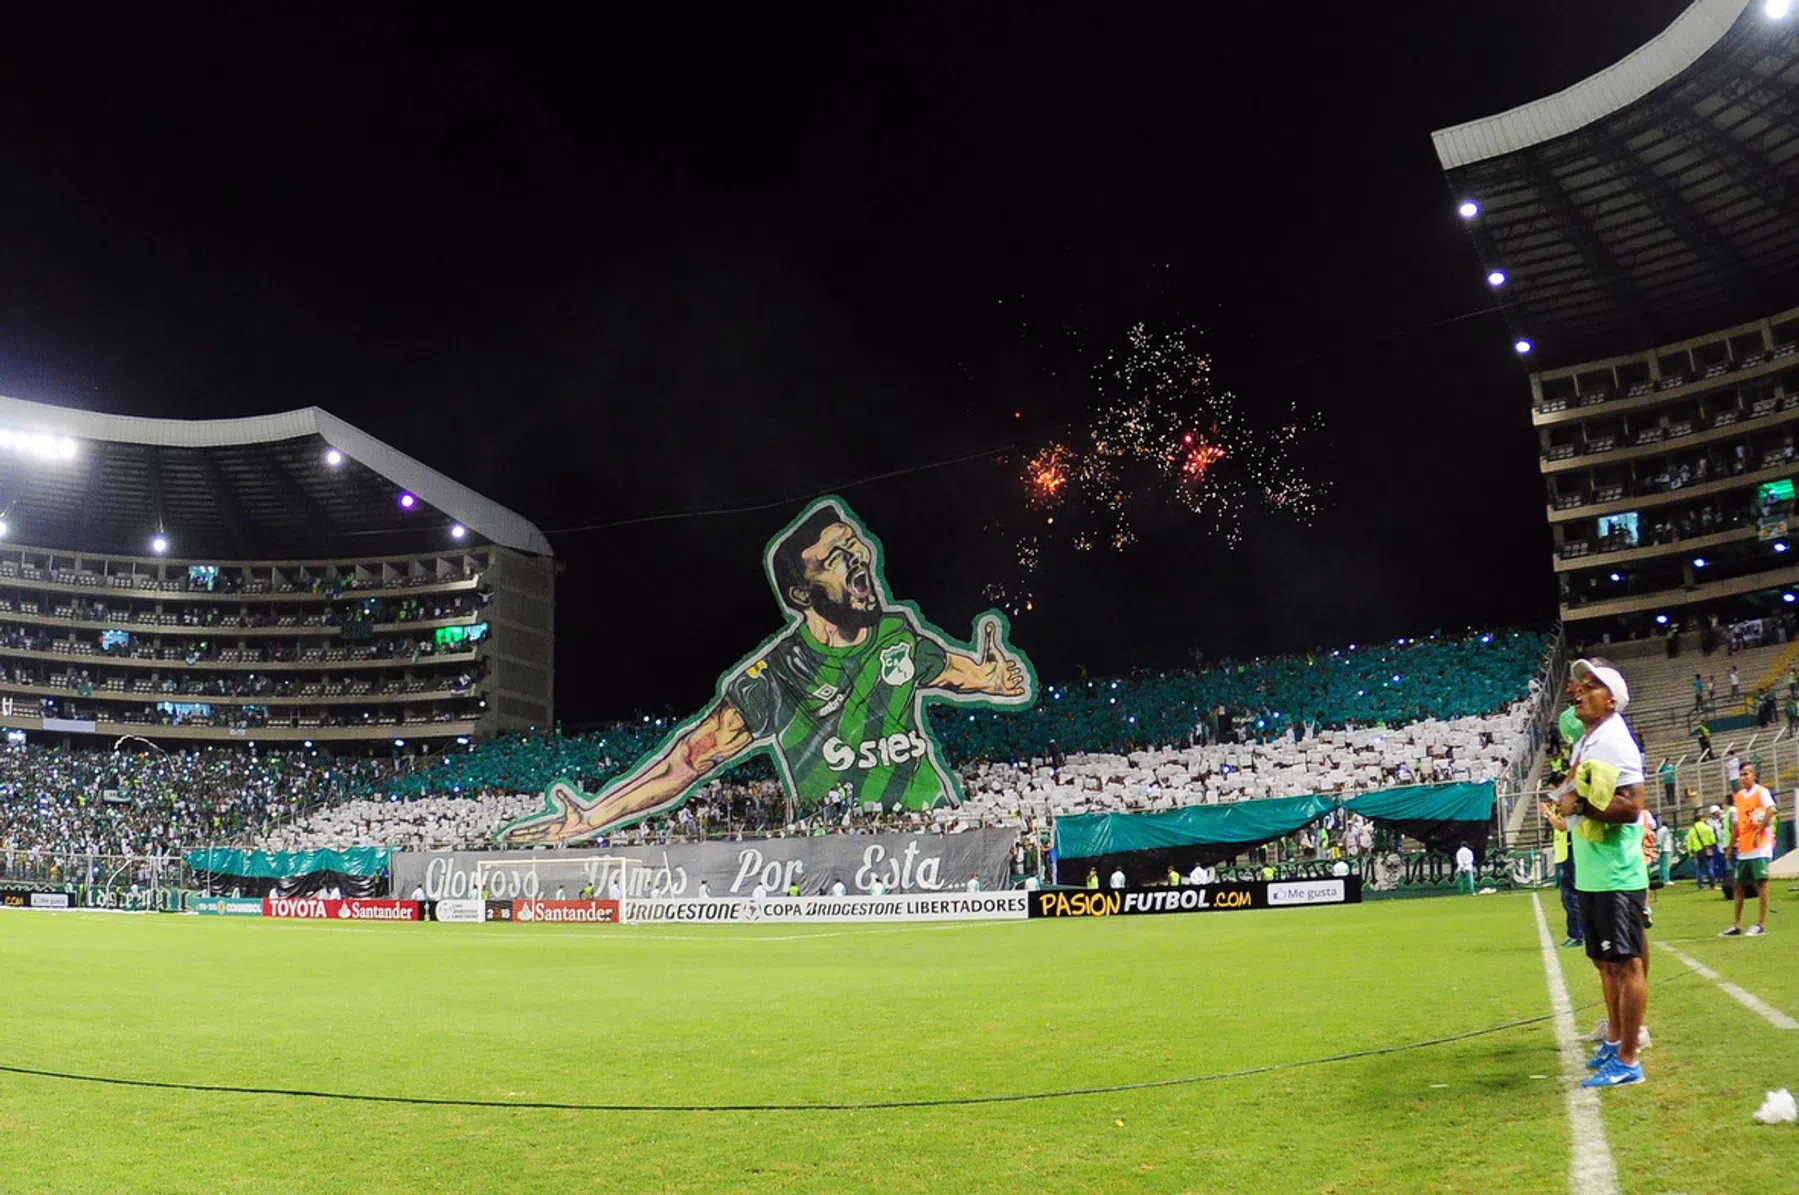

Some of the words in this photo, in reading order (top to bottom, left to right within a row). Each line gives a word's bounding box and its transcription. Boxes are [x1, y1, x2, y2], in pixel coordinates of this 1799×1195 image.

[730, 849, 804, 894] Por
[1039, 891, 1121, 916] PASION
[1123, 889, 1210, 912] FUTBOL
[1287, 889, 1305, 899] Me
[1308, 888, 1338, 900] gusta
[269, 900, 327, 918] TOYOTA
[352, 901, 412, 919] Santander
[535, 902, 612, 922] Santander
[625, 902, 741, 920] BRIDGESTONE
[763, 904, 802, 916] COPA
[805, 902, 903, 916] BRIDGESTONE
[907, 898, 1026, 914] LIBERTADORES
